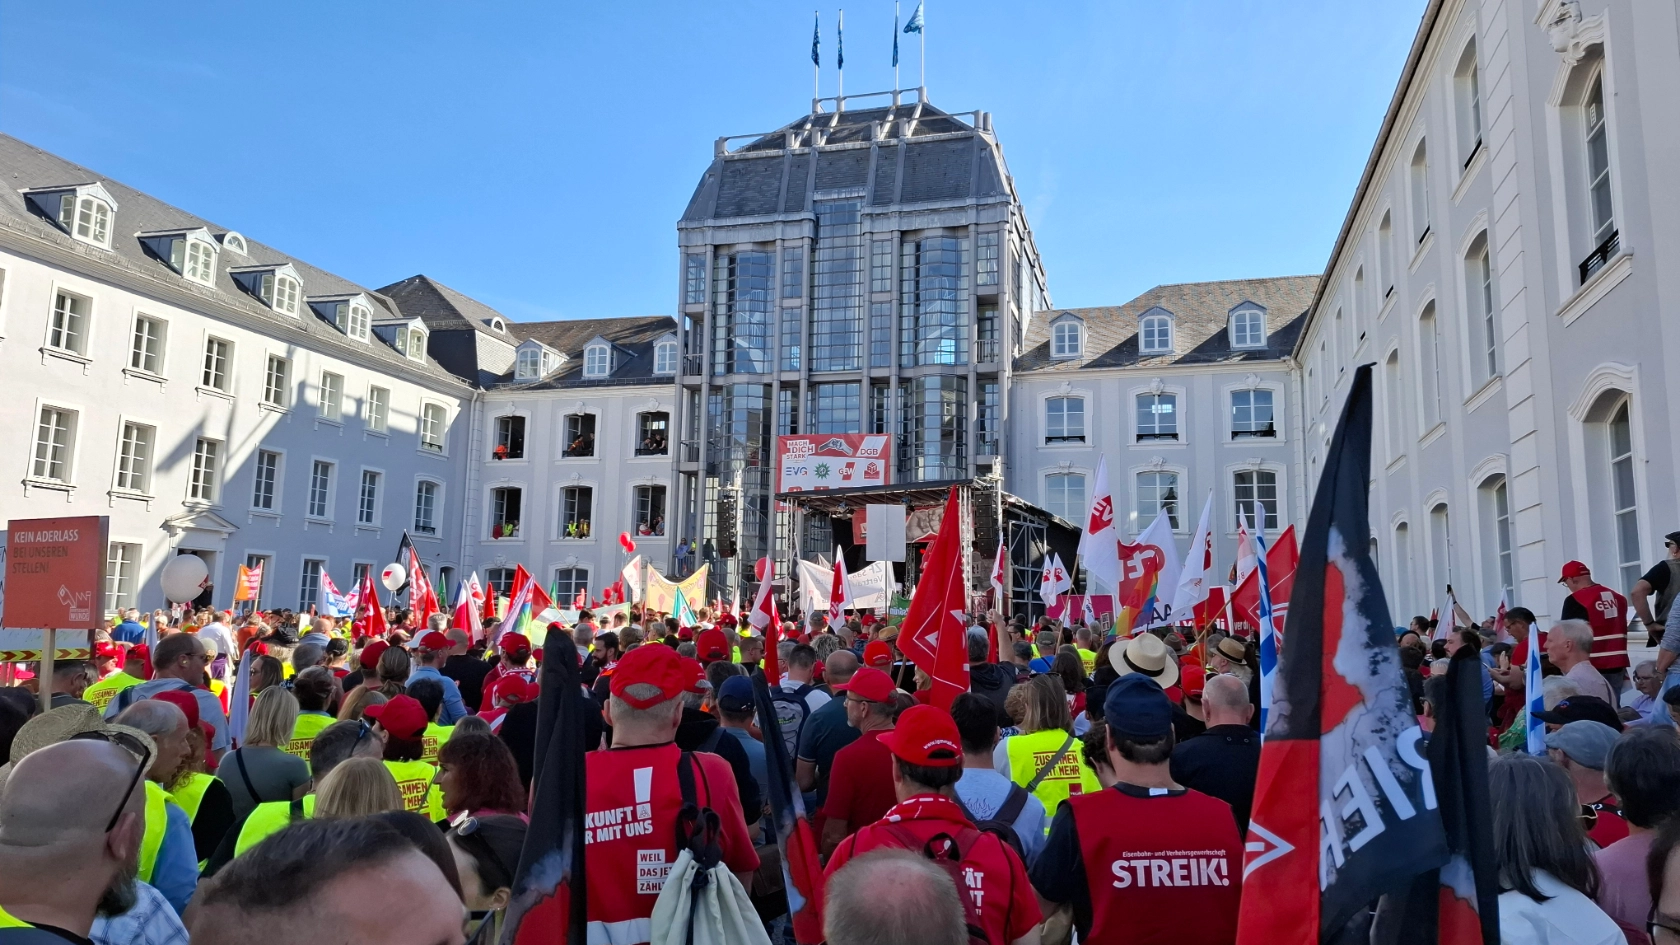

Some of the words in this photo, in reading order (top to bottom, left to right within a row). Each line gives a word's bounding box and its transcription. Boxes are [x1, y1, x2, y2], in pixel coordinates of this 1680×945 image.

[791, 446, 814, 454] DICH
[786, 467, 808, 476] EVG
[14, 531, 34, 543] KEIN
[35, 529, 79, 542] ADERLASS
[13, 547, 27, 558] BEI
[29, 546, 68, 557] UNSEREN
[12, 562, 49, 574] STELLEN!
[1595, 599, 1618, 611] GEW
[1059, 765, 1080, 776] MEHR
[596, 825, 622, 843] MIT
[625, 820, 653, 837] UNS
[640, 853, 662, 862] WEIL
[1166, 849, 1226, 857] Verkehrsgewerkschaft
[640, 868, 658, 877] DAS
[1111, 858, 1230, 889] STREIK!
